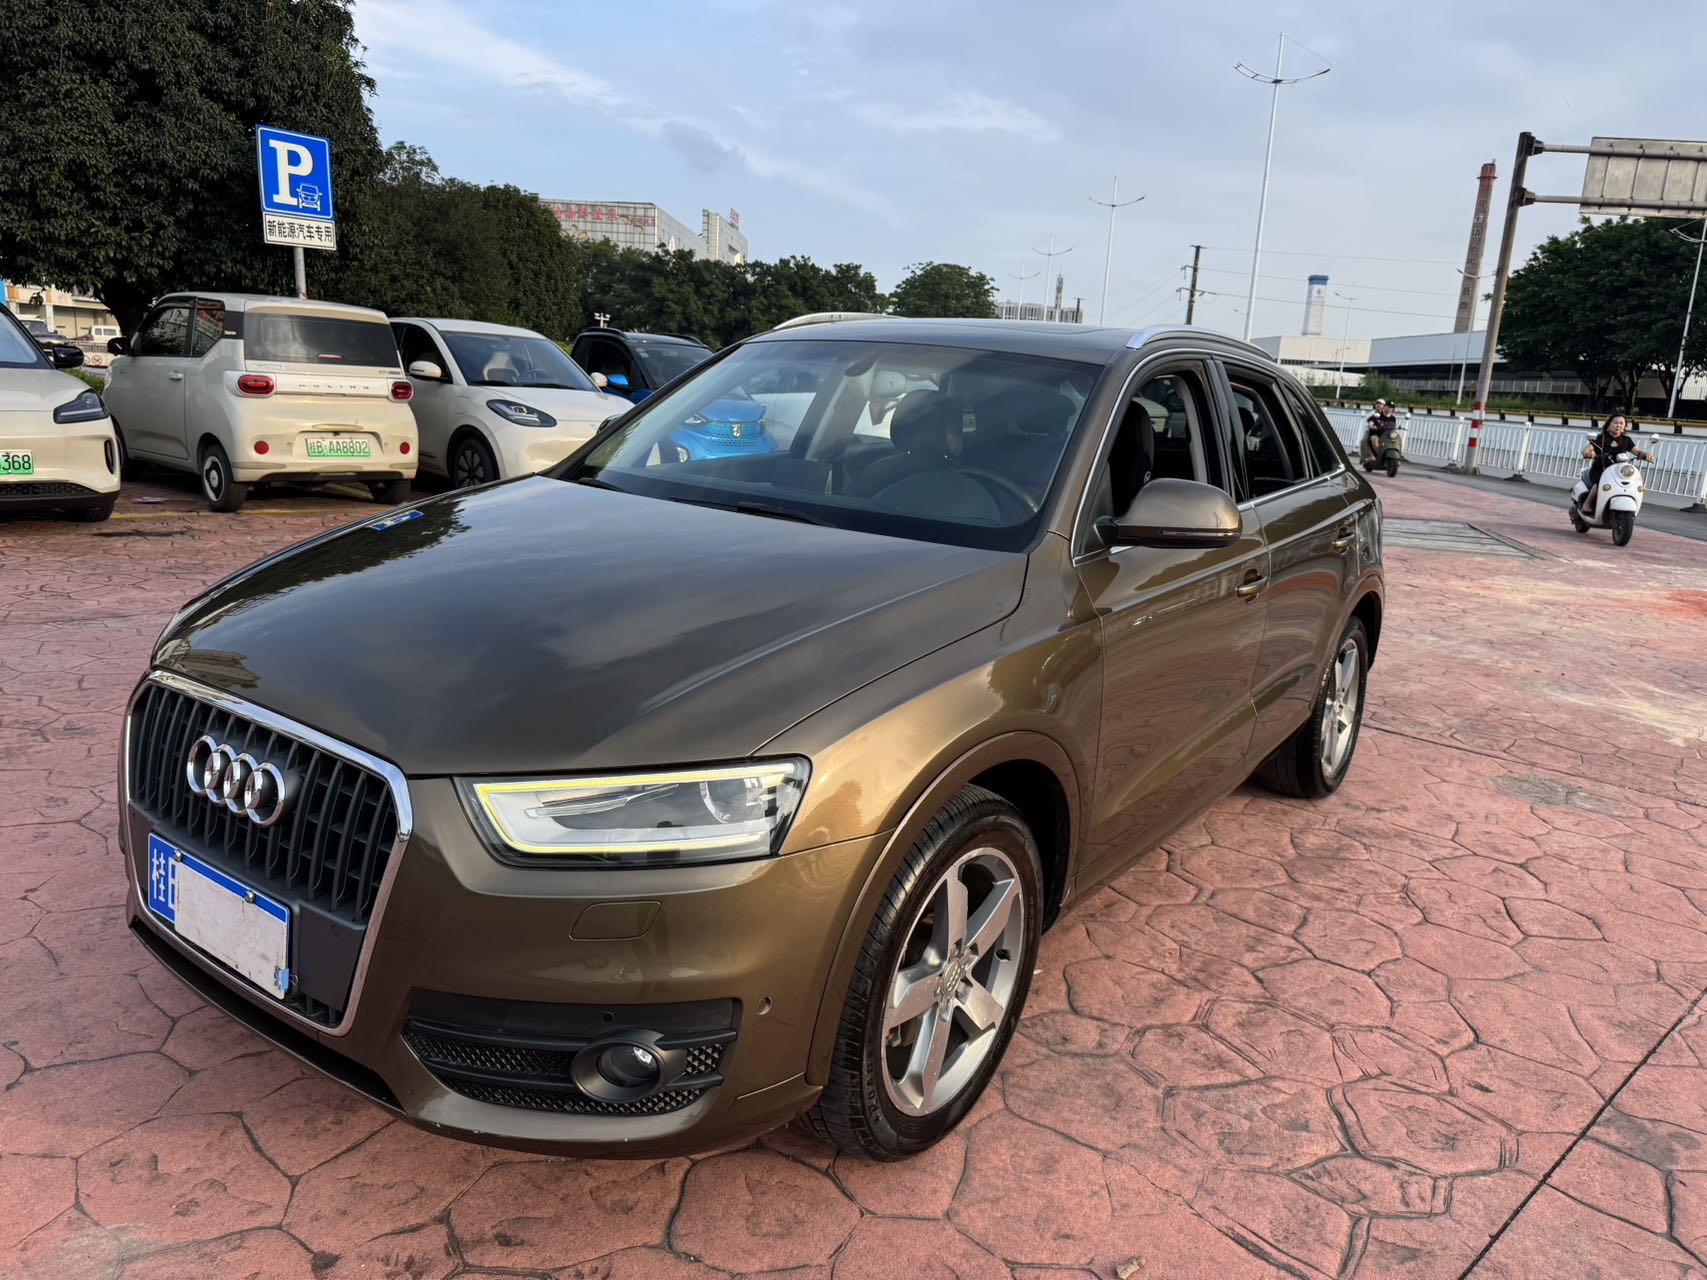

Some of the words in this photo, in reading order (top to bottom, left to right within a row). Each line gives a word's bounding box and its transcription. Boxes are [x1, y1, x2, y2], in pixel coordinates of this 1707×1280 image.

[268, 139, 314, 206] P
[267, 219, 333, 243] 新能源汽车专用
[0, 454, 31, 471] 368
